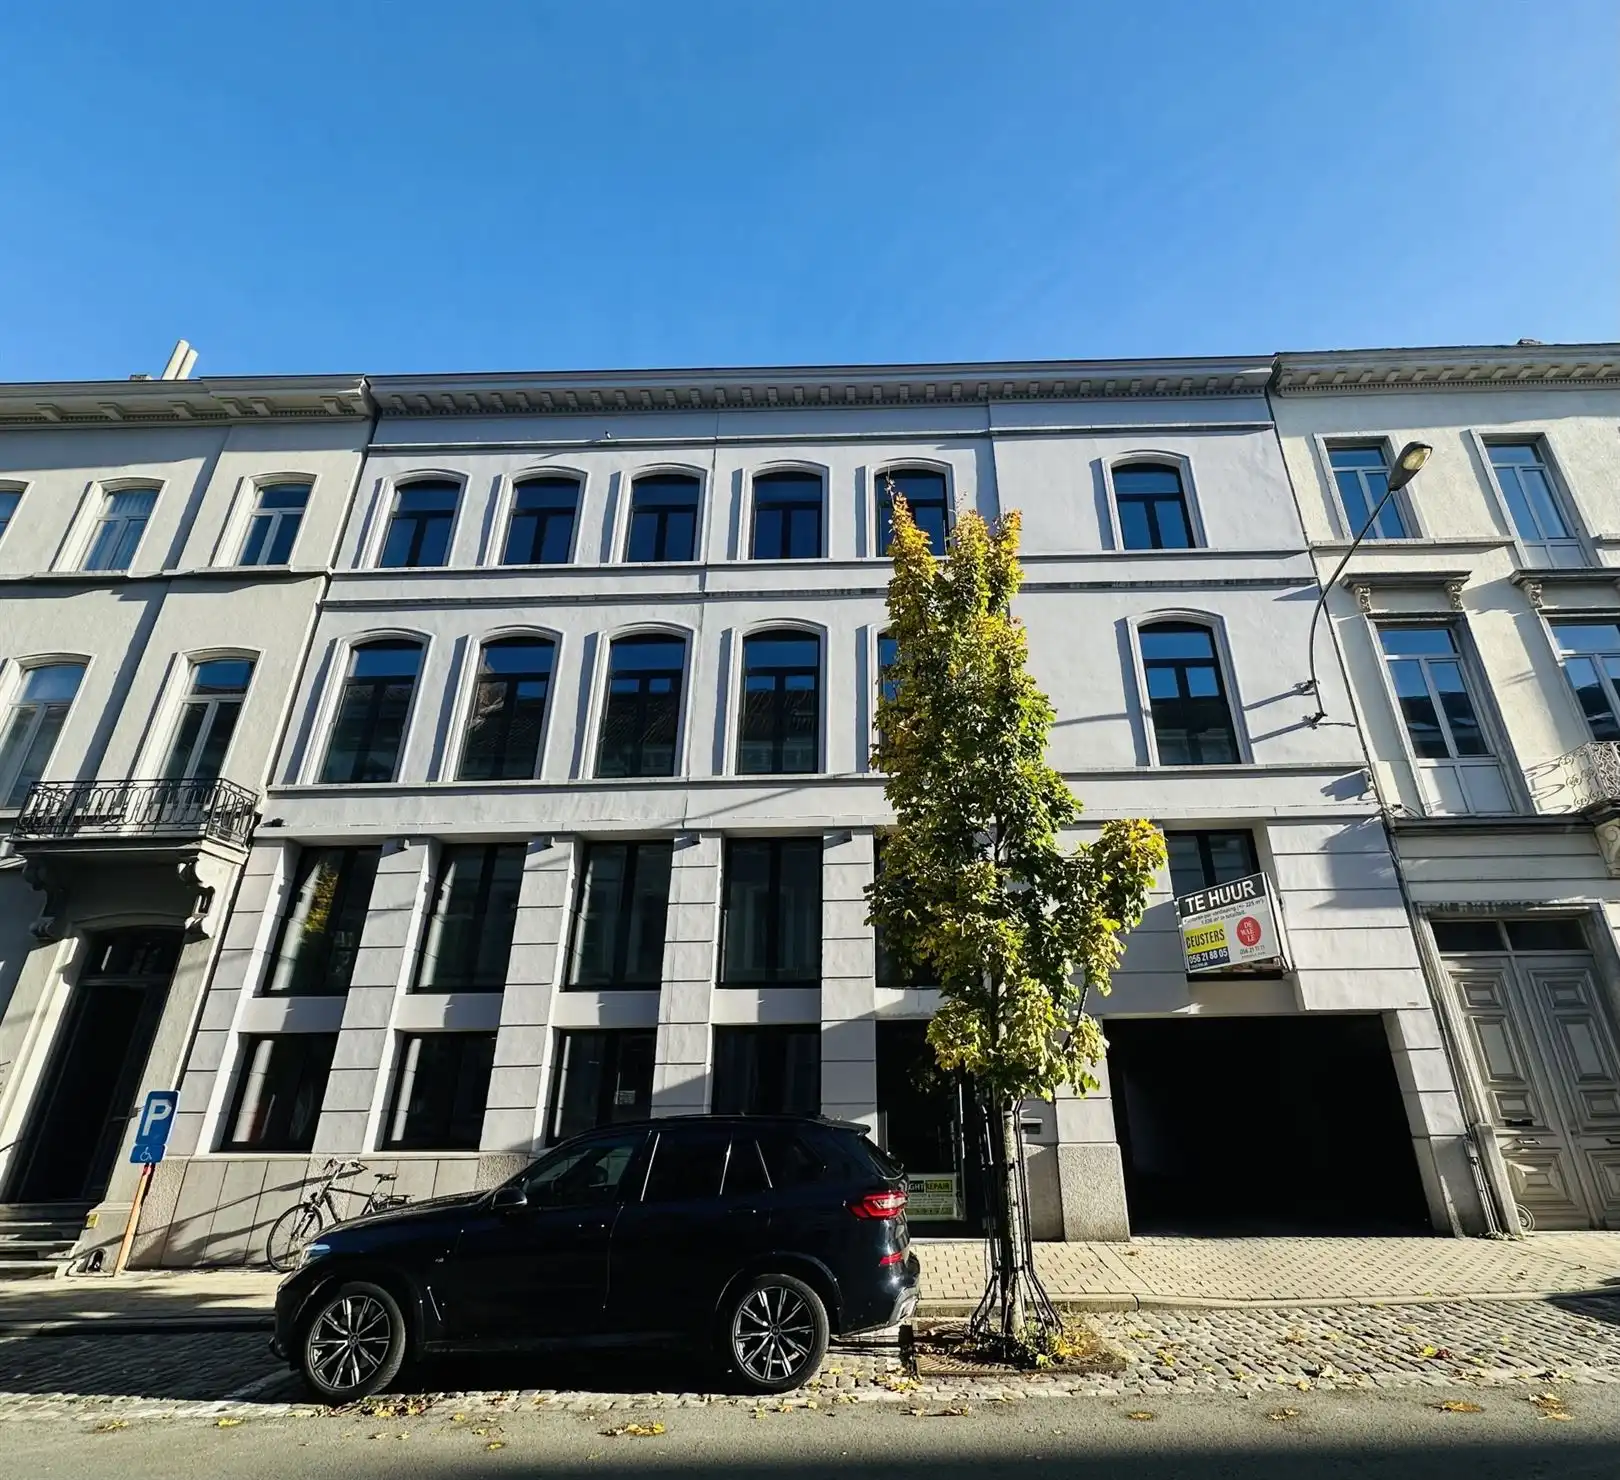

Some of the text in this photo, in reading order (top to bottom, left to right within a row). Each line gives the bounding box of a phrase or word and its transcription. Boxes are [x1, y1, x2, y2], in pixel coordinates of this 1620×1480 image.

[1185, 880, 1256, 913] TE HUUR
[1185, 928, 1225, 949] CEUSTERS
[1201, 951, 1209, 961] 21
[1209, 949, 1219, 960] 88
[1218, 947, 1228, 958] 05
[142, 1099, 172, 1136] P
